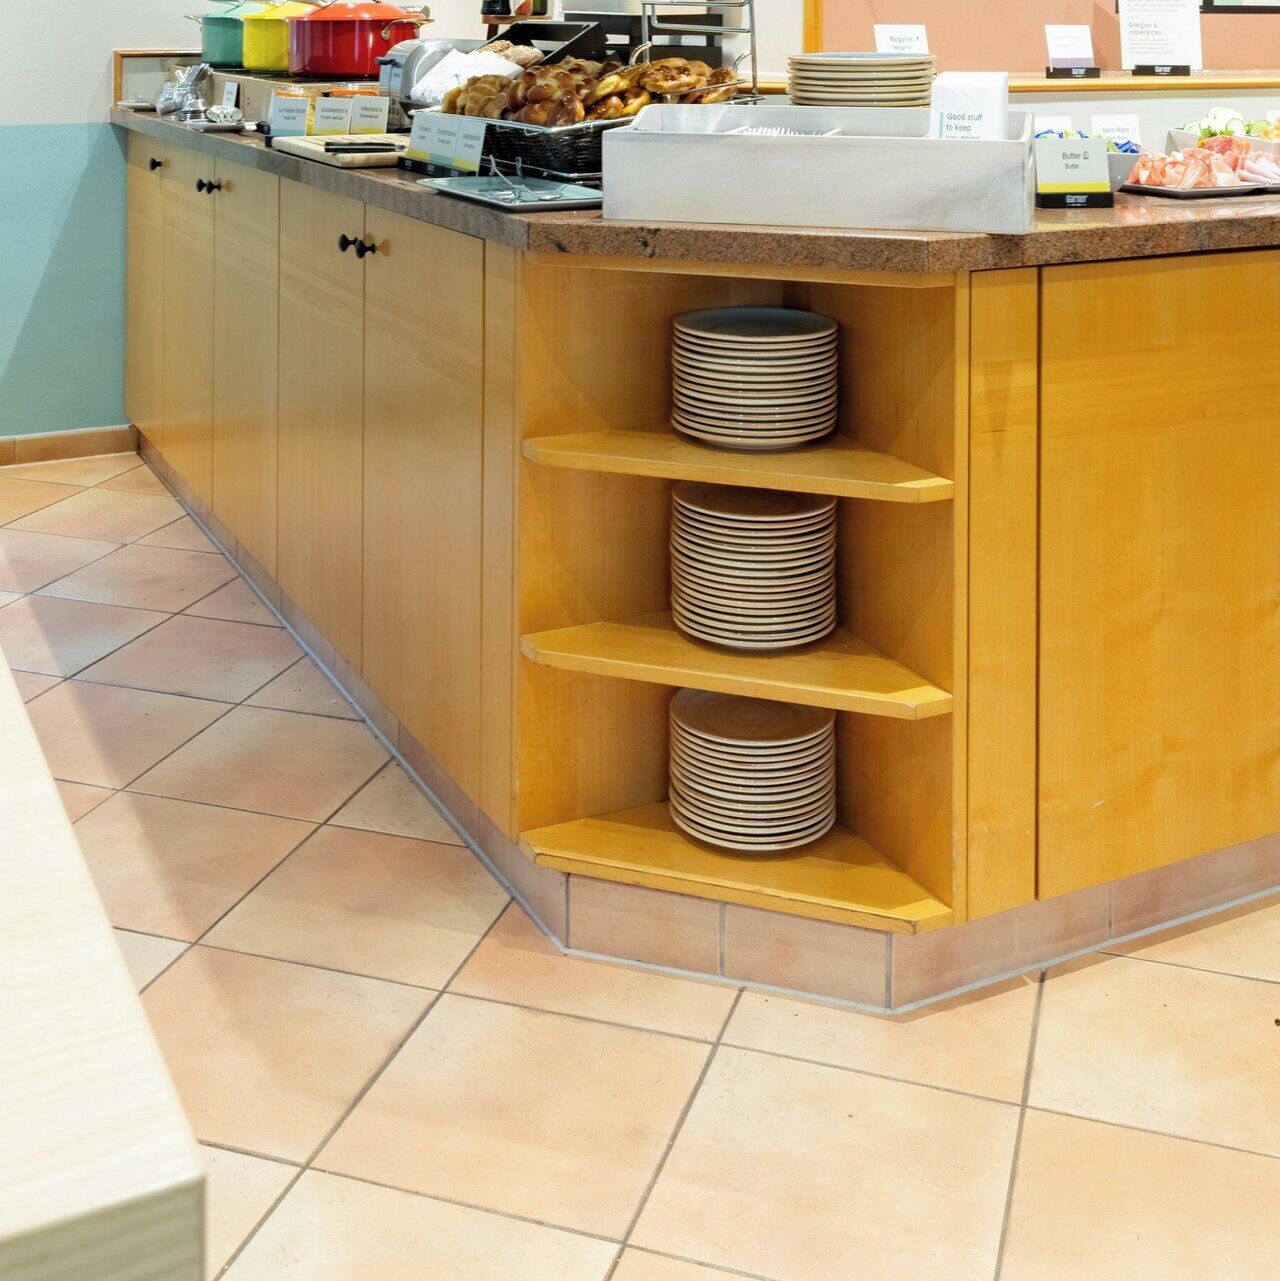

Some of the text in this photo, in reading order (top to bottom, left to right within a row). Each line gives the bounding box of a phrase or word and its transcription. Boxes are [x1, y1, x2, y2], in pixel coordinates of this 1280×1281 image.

[947, 113, 983, 121] Good stuff
[946, 123, 971, 133] to keep
[1061, 152, 1081, 160] Butter
